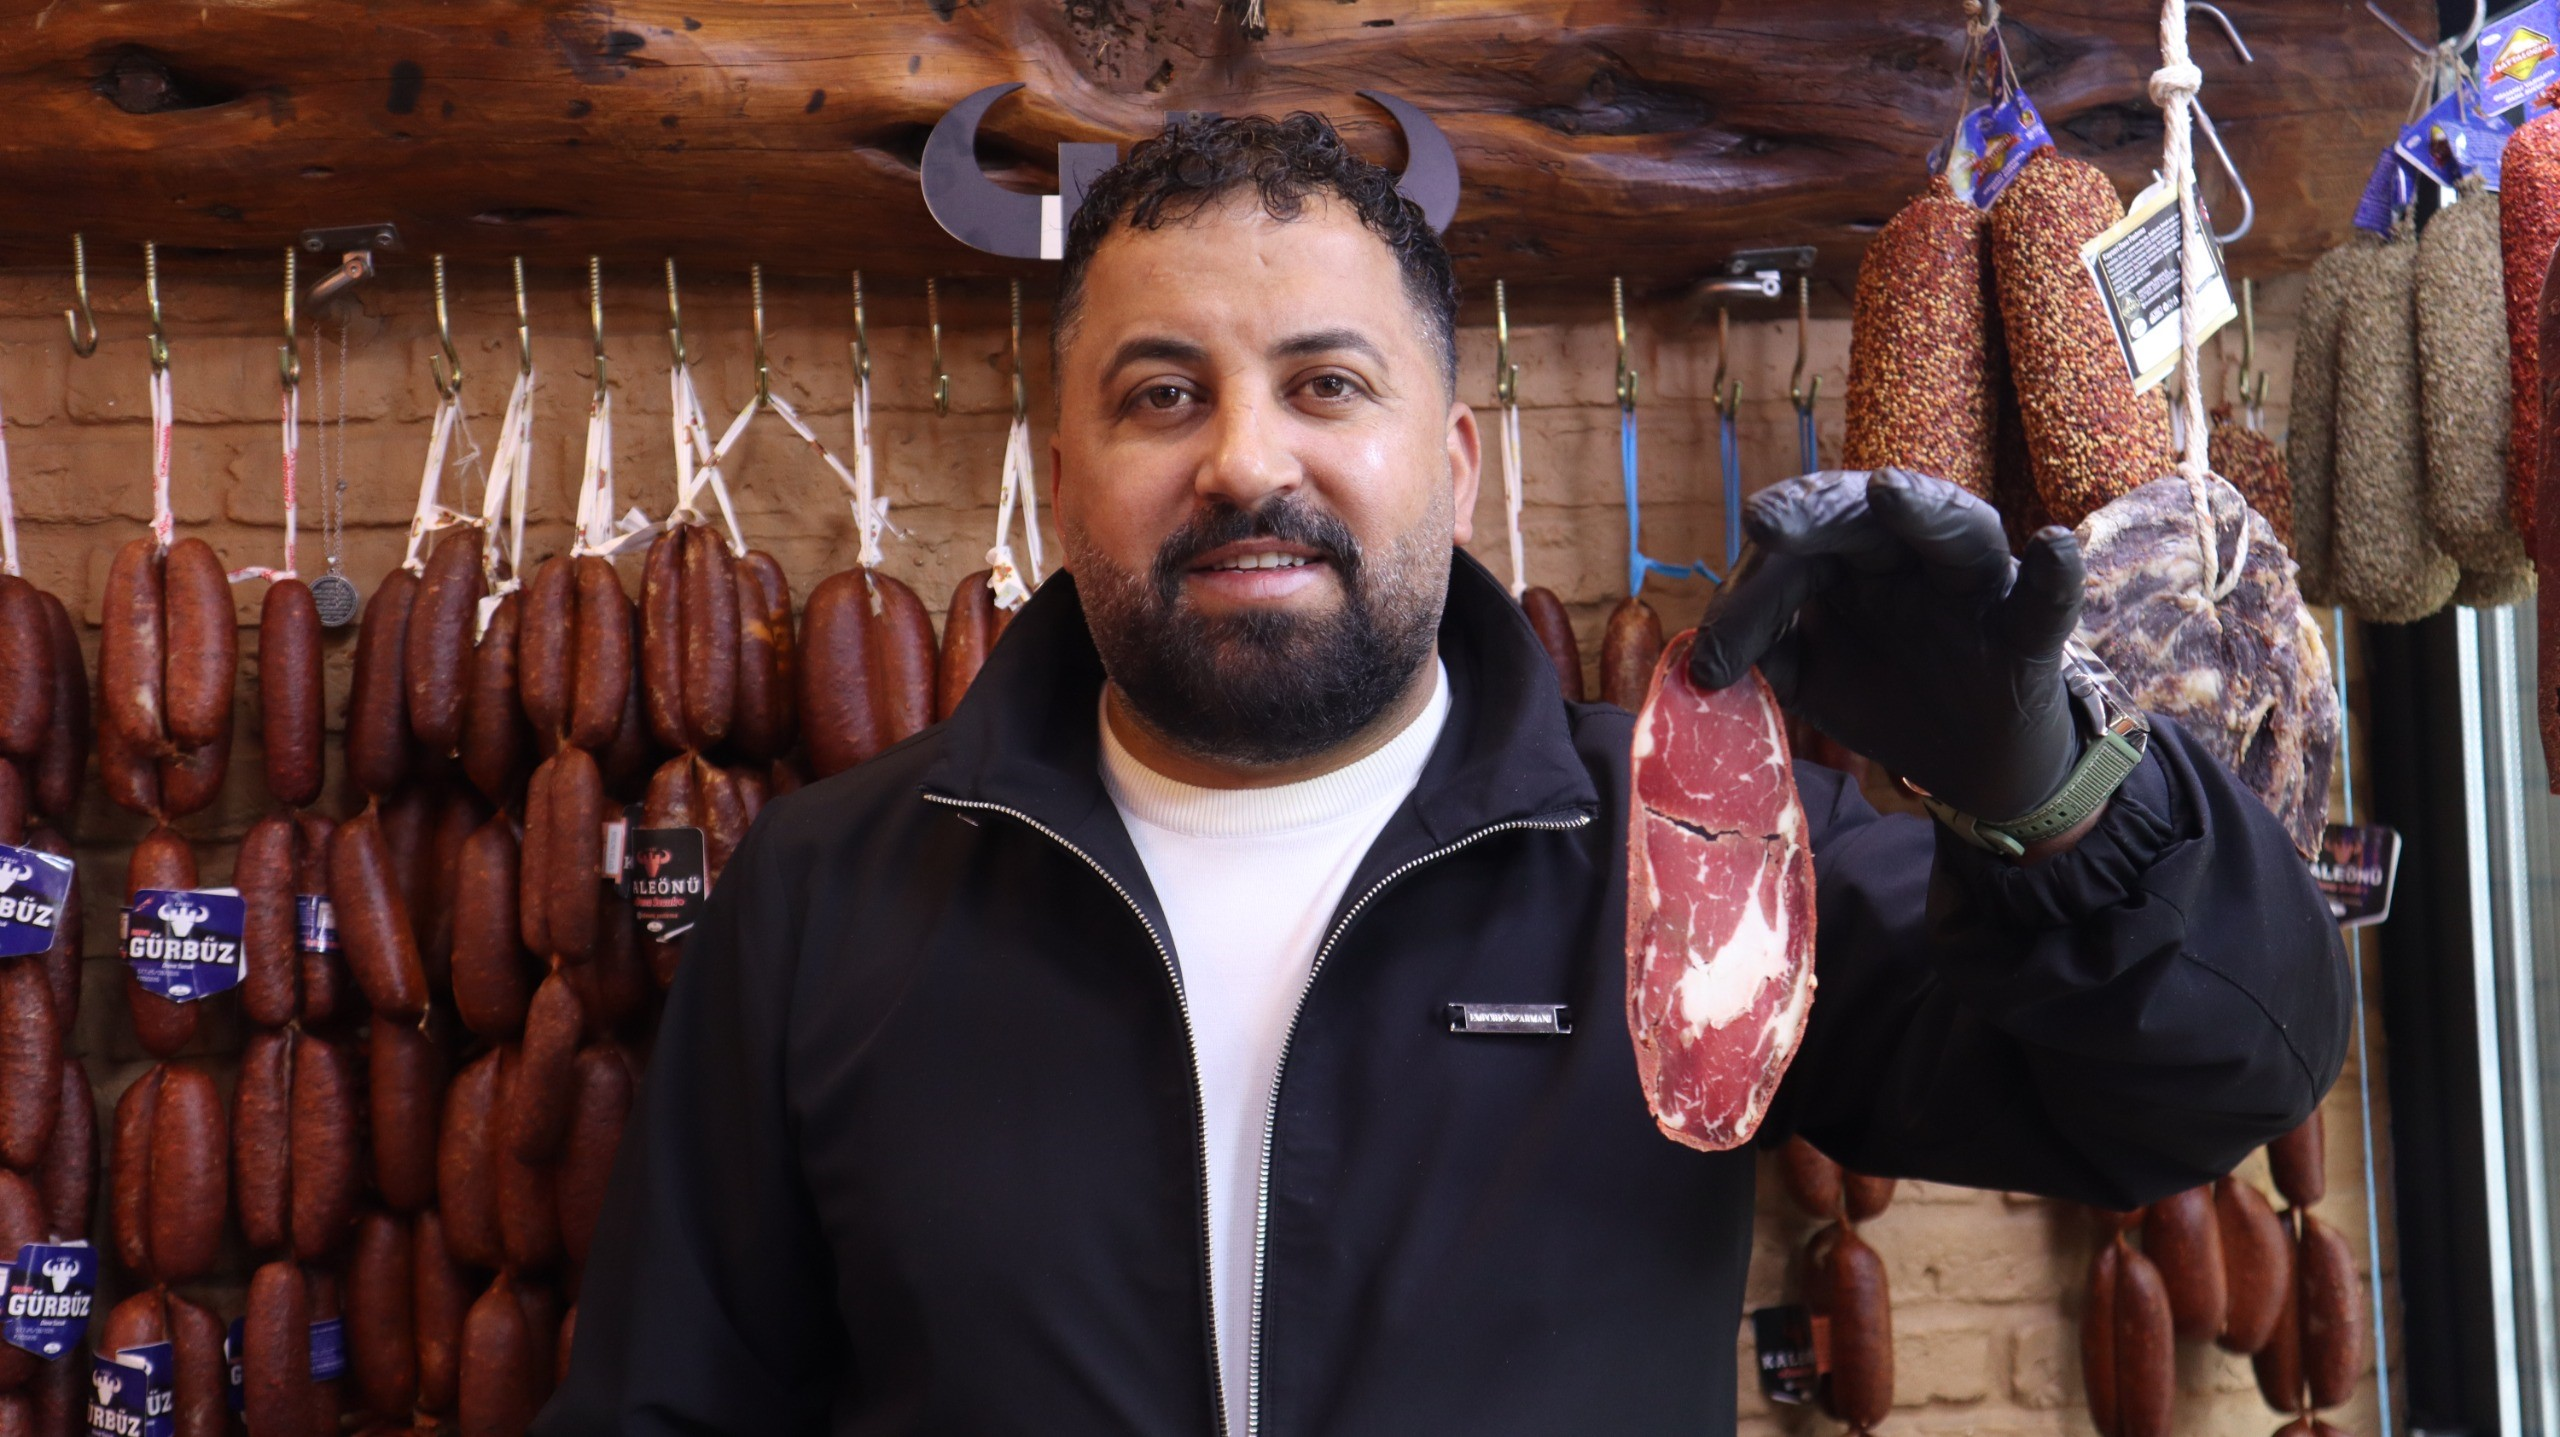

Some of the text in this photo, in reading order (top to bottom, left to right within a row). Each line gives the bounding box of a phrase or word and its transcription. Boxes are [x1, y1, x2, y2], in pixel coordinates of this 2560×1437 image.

[633, 877, 700, 895] ALEÖNÜ
[0, 896, 54, 927] BÜZ
[129, 932, 235, 963] GÜRBÜZ
[8, 1290, 91, 1317] GÜRBÜZ
